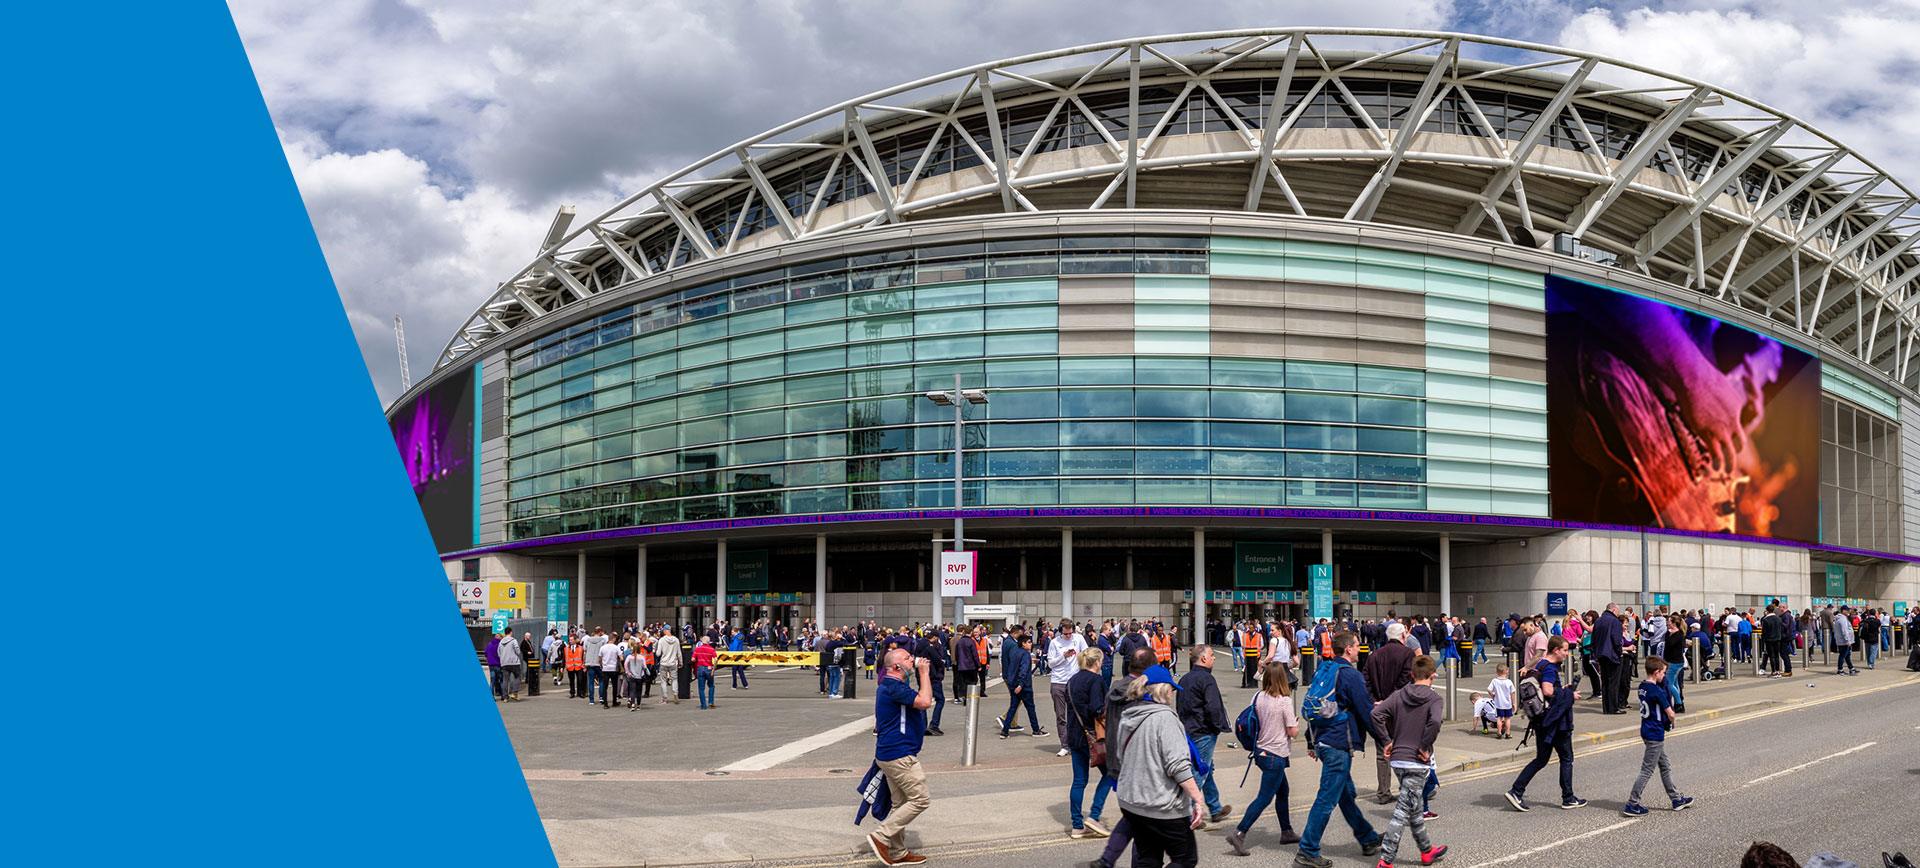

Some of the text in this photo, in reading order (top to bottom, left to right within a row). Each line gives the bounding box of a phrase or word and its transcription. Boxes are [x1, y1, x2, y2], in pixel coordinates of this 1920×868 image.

[823, 510, 918, 522] WEMBLEY CONNECTED BY EE
[962, 509, 1007, 517] CONNECTED
[1008, 508, 1018, 516] BY
[1018, 508, 1028, 516] EE
[1037, 507, 1144, 516] WEMBLEY CONNECTED BY EE
[1152, 507, 1259, 516] WEMBLEY CONNECTED BY EE
[1268, 508, 1304, 517] WEMBLEY
[1304, 509, 1349, 518] CONNECTED
[1350, 510, 1360, 518] BY
[1377, 511, 1471, 522] WEMBLEY CONNECTED BY EE
[1477, 515, 1508, 525] WEMBLEY
[1509, 517, 1544, 526] CONNECTED
[1545, 519, 1553, 527] BY
[733, 515, 817, 528] WEMBLEY CONNECTED BY EE
[1245, 555, 1284, 563] Entrance N
[947, 564, 967, 573] RVP
[1252, 565, 1277, 573] Level 1
[1318, 567, 1327, 577] N
[549, 582, 556, 590] M
[559, 582, 567, 590] M
[944, 578, 970, 586] SOUTH
[755, 595, 761, 603] M
[1241, 592, 1248, 600] N
[1281, 592, 1288, 600] N
[496, 620, 504, 632] 3
